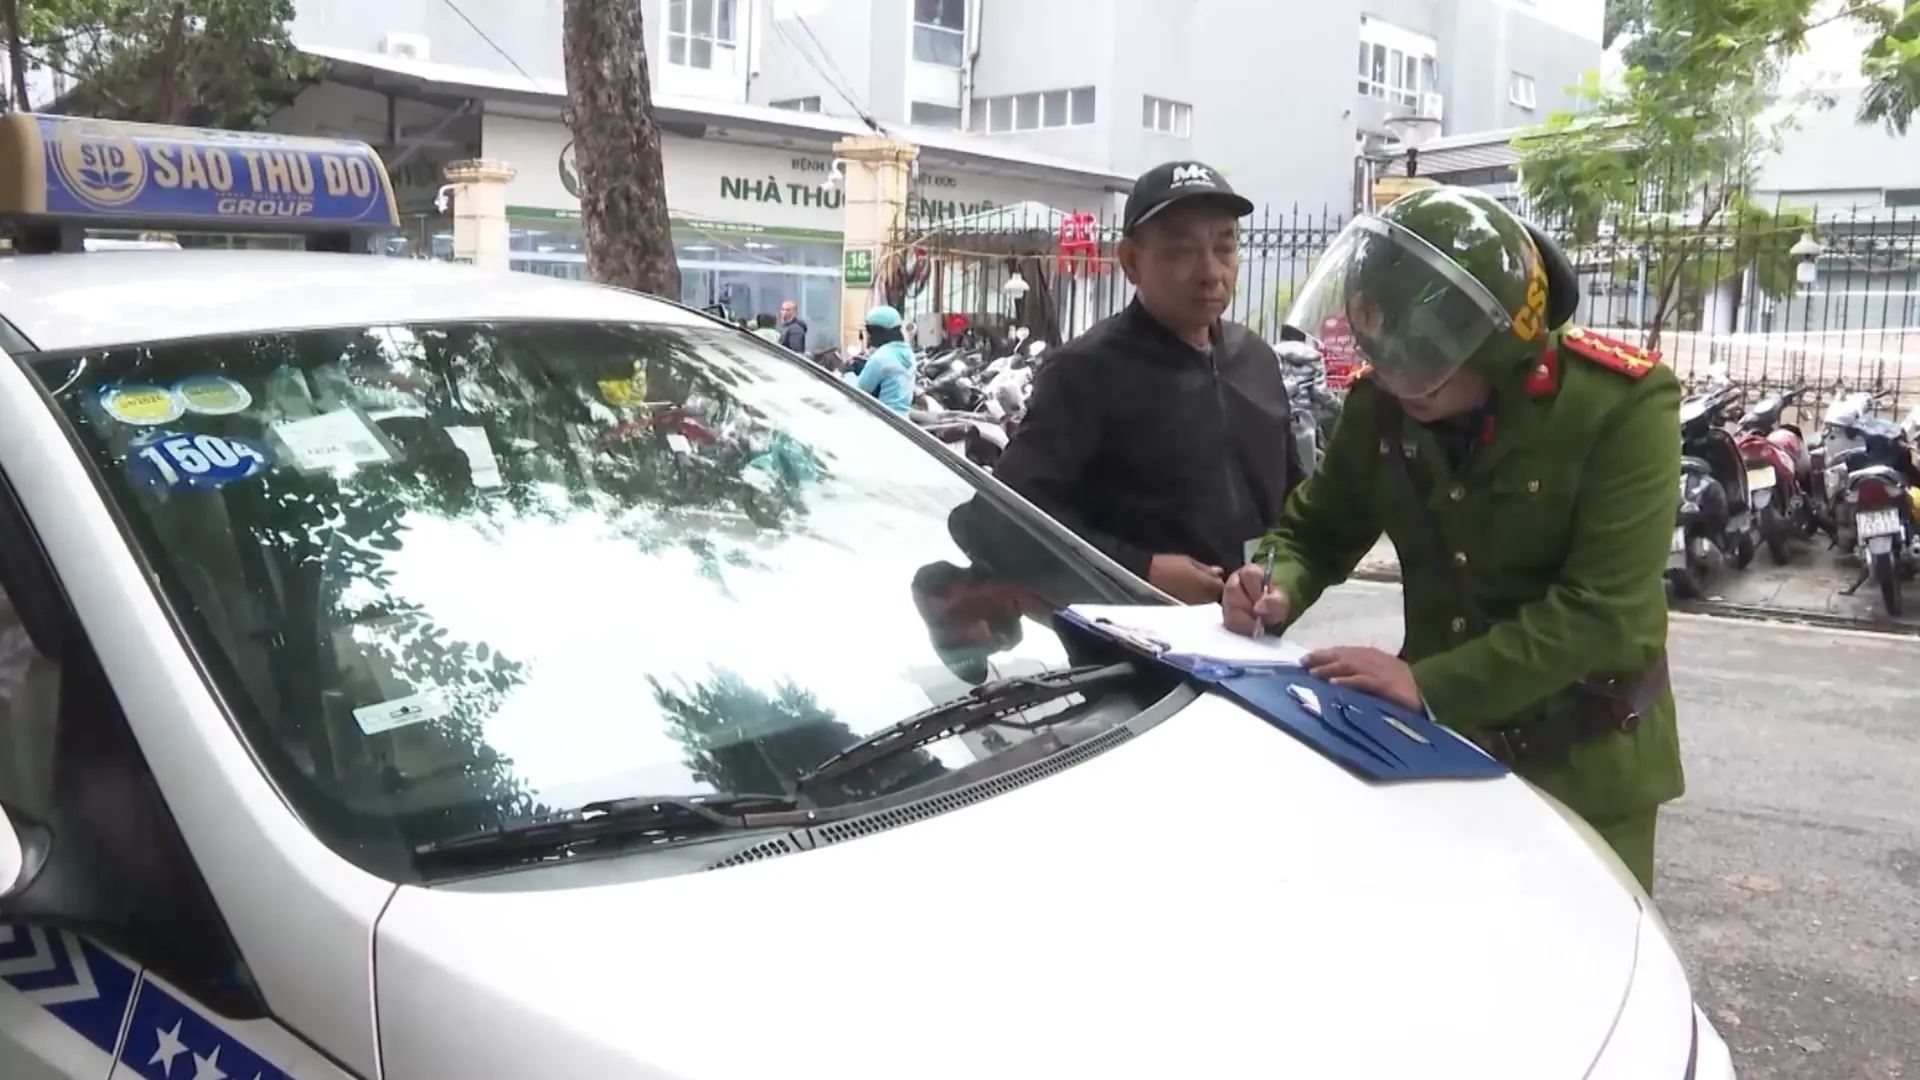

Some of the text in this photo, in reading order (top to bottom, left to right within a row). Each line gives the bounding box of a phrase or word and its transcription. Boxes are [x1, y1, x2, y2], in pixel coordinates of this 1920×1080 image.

[150, 145, 233, 191] SAO
[1173, 163, 1213, 182] MK
[720, 175, 782, 204] NHÀ
[786, 183, 846, 209] THU
[217, 198, 313, 216] GROUP
[850, 252, 866, 268] 16
